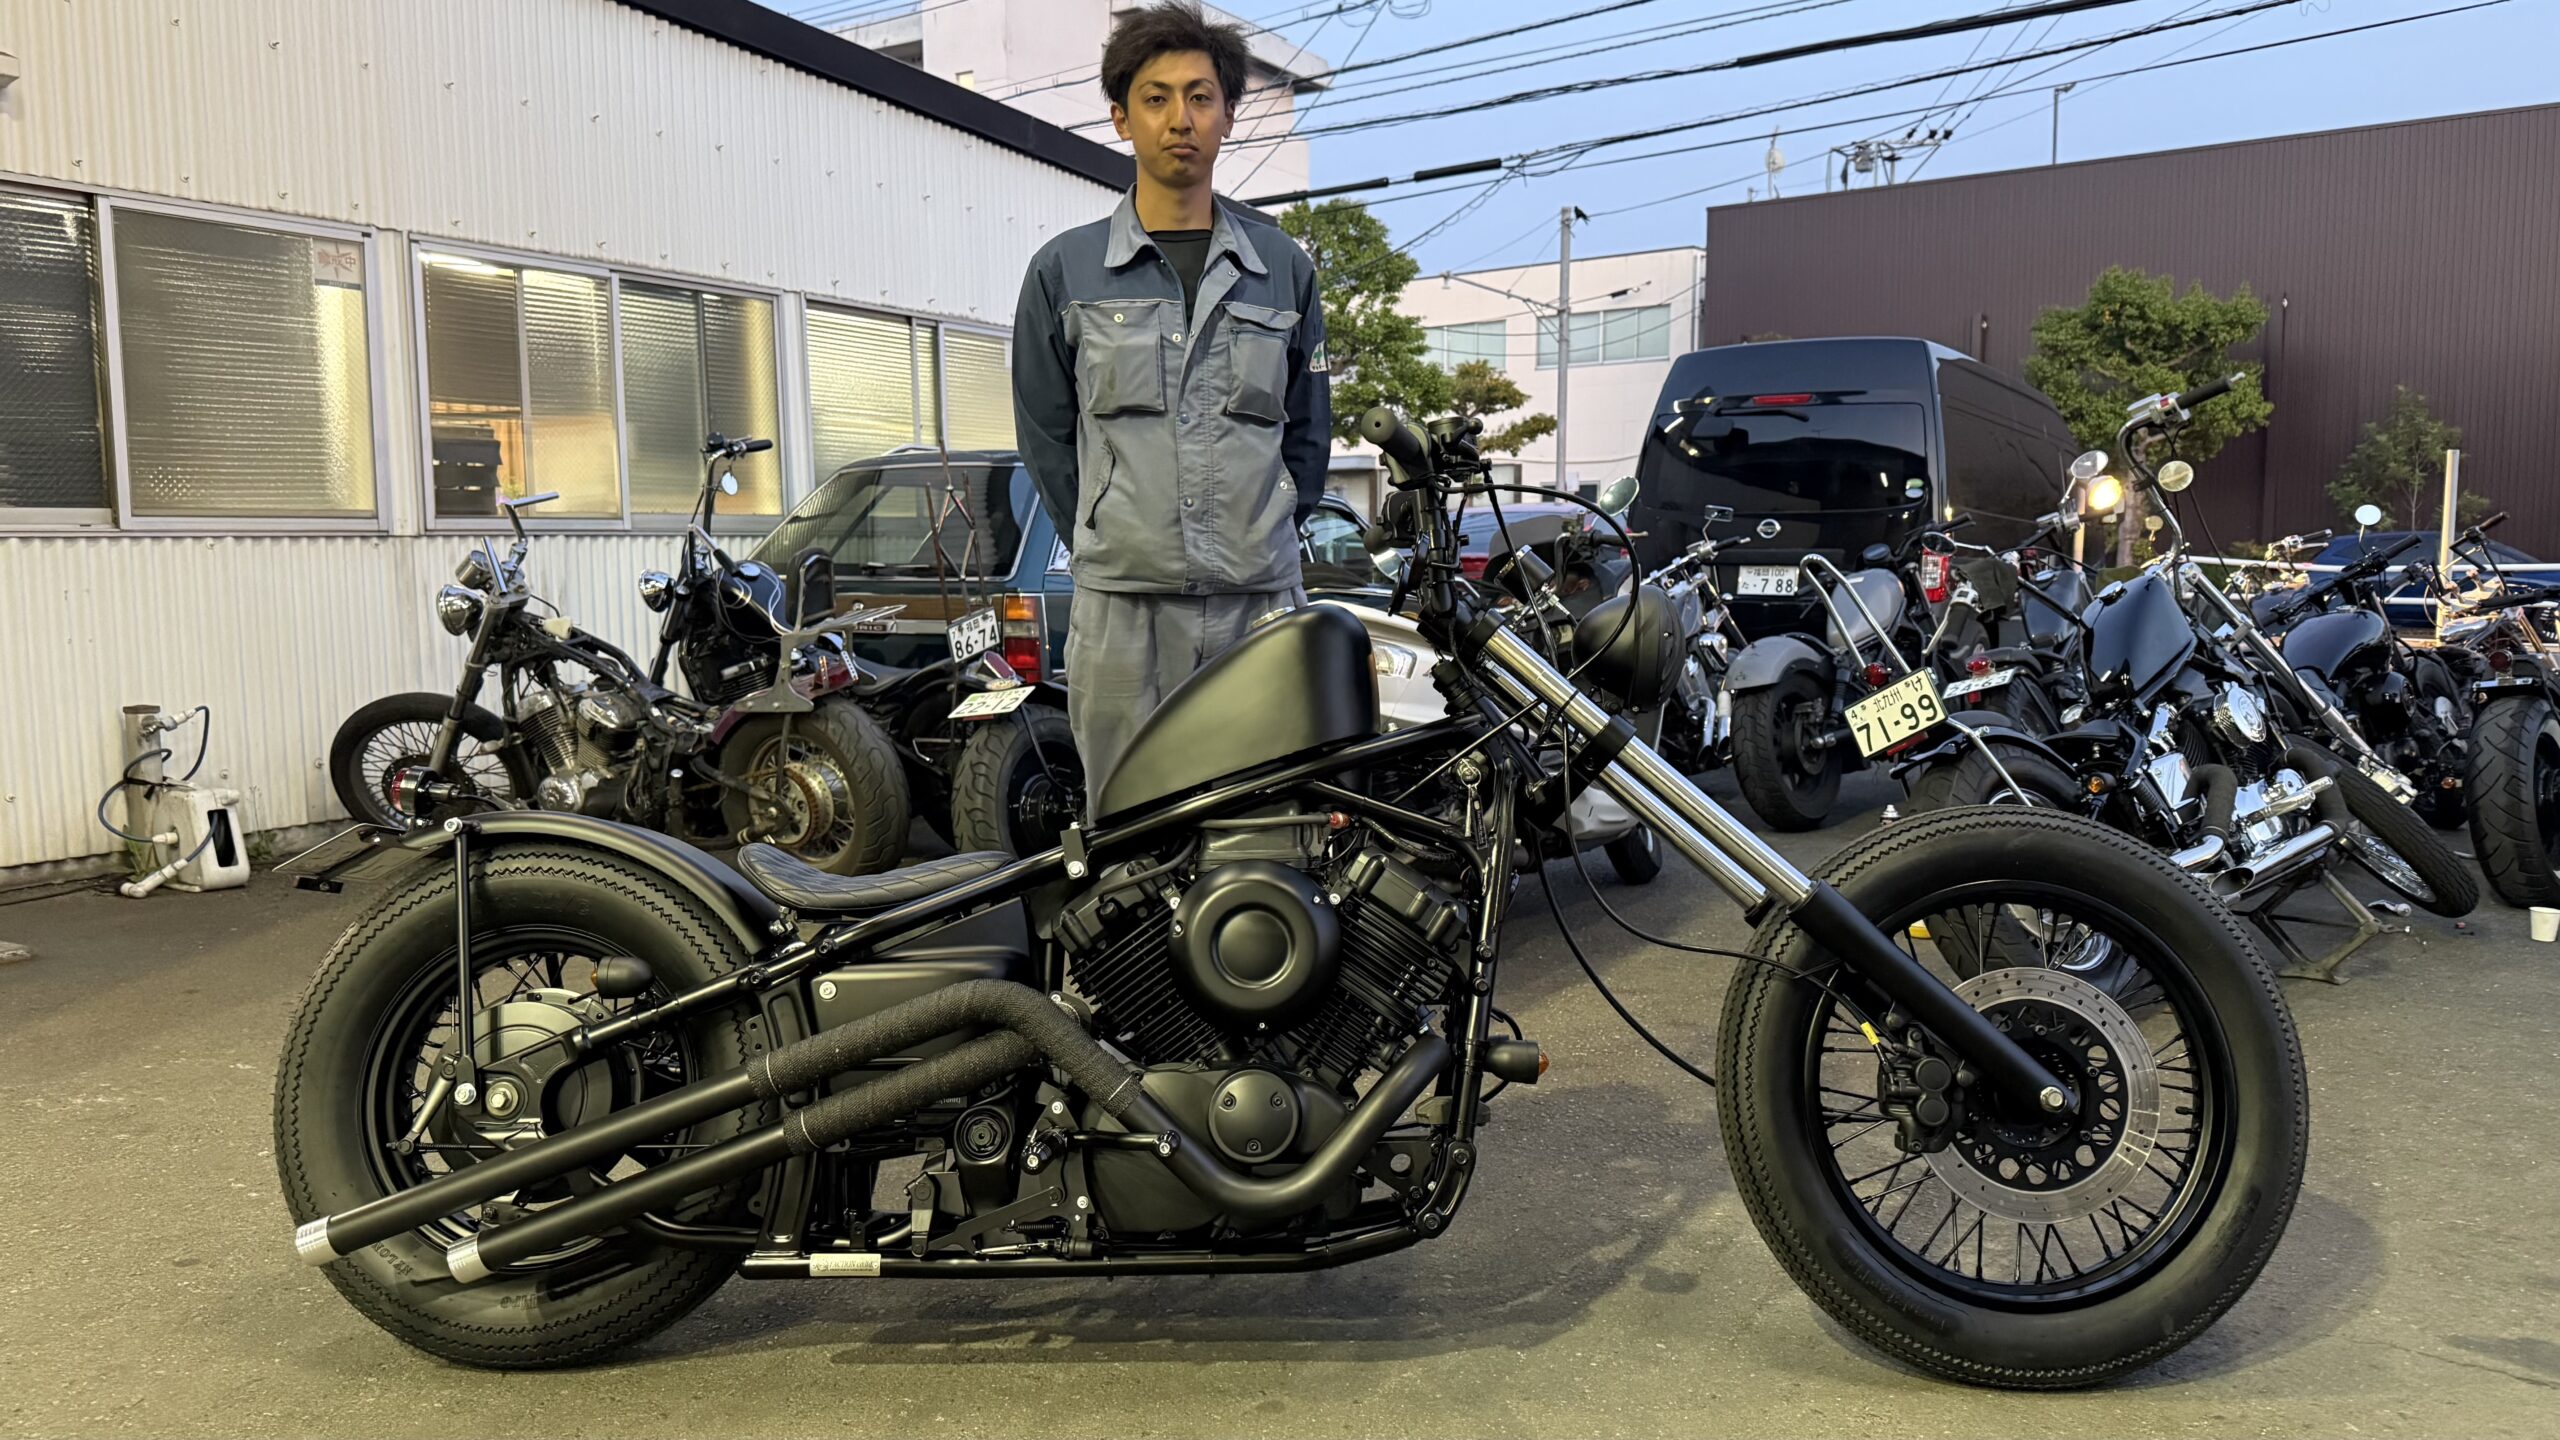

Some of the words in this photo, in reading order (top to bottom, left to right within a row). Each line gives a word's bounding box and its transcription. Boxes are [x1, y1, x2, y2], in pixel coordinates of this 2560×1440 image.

[954, 624, 998, 660] 86-74
[954, 697, 1020, 715] 22-12
[1873, 687, 1904, 713] 北九州
[1911, 675, 1925, 693] け
[1856, 693, 1938, 752] 71-99
